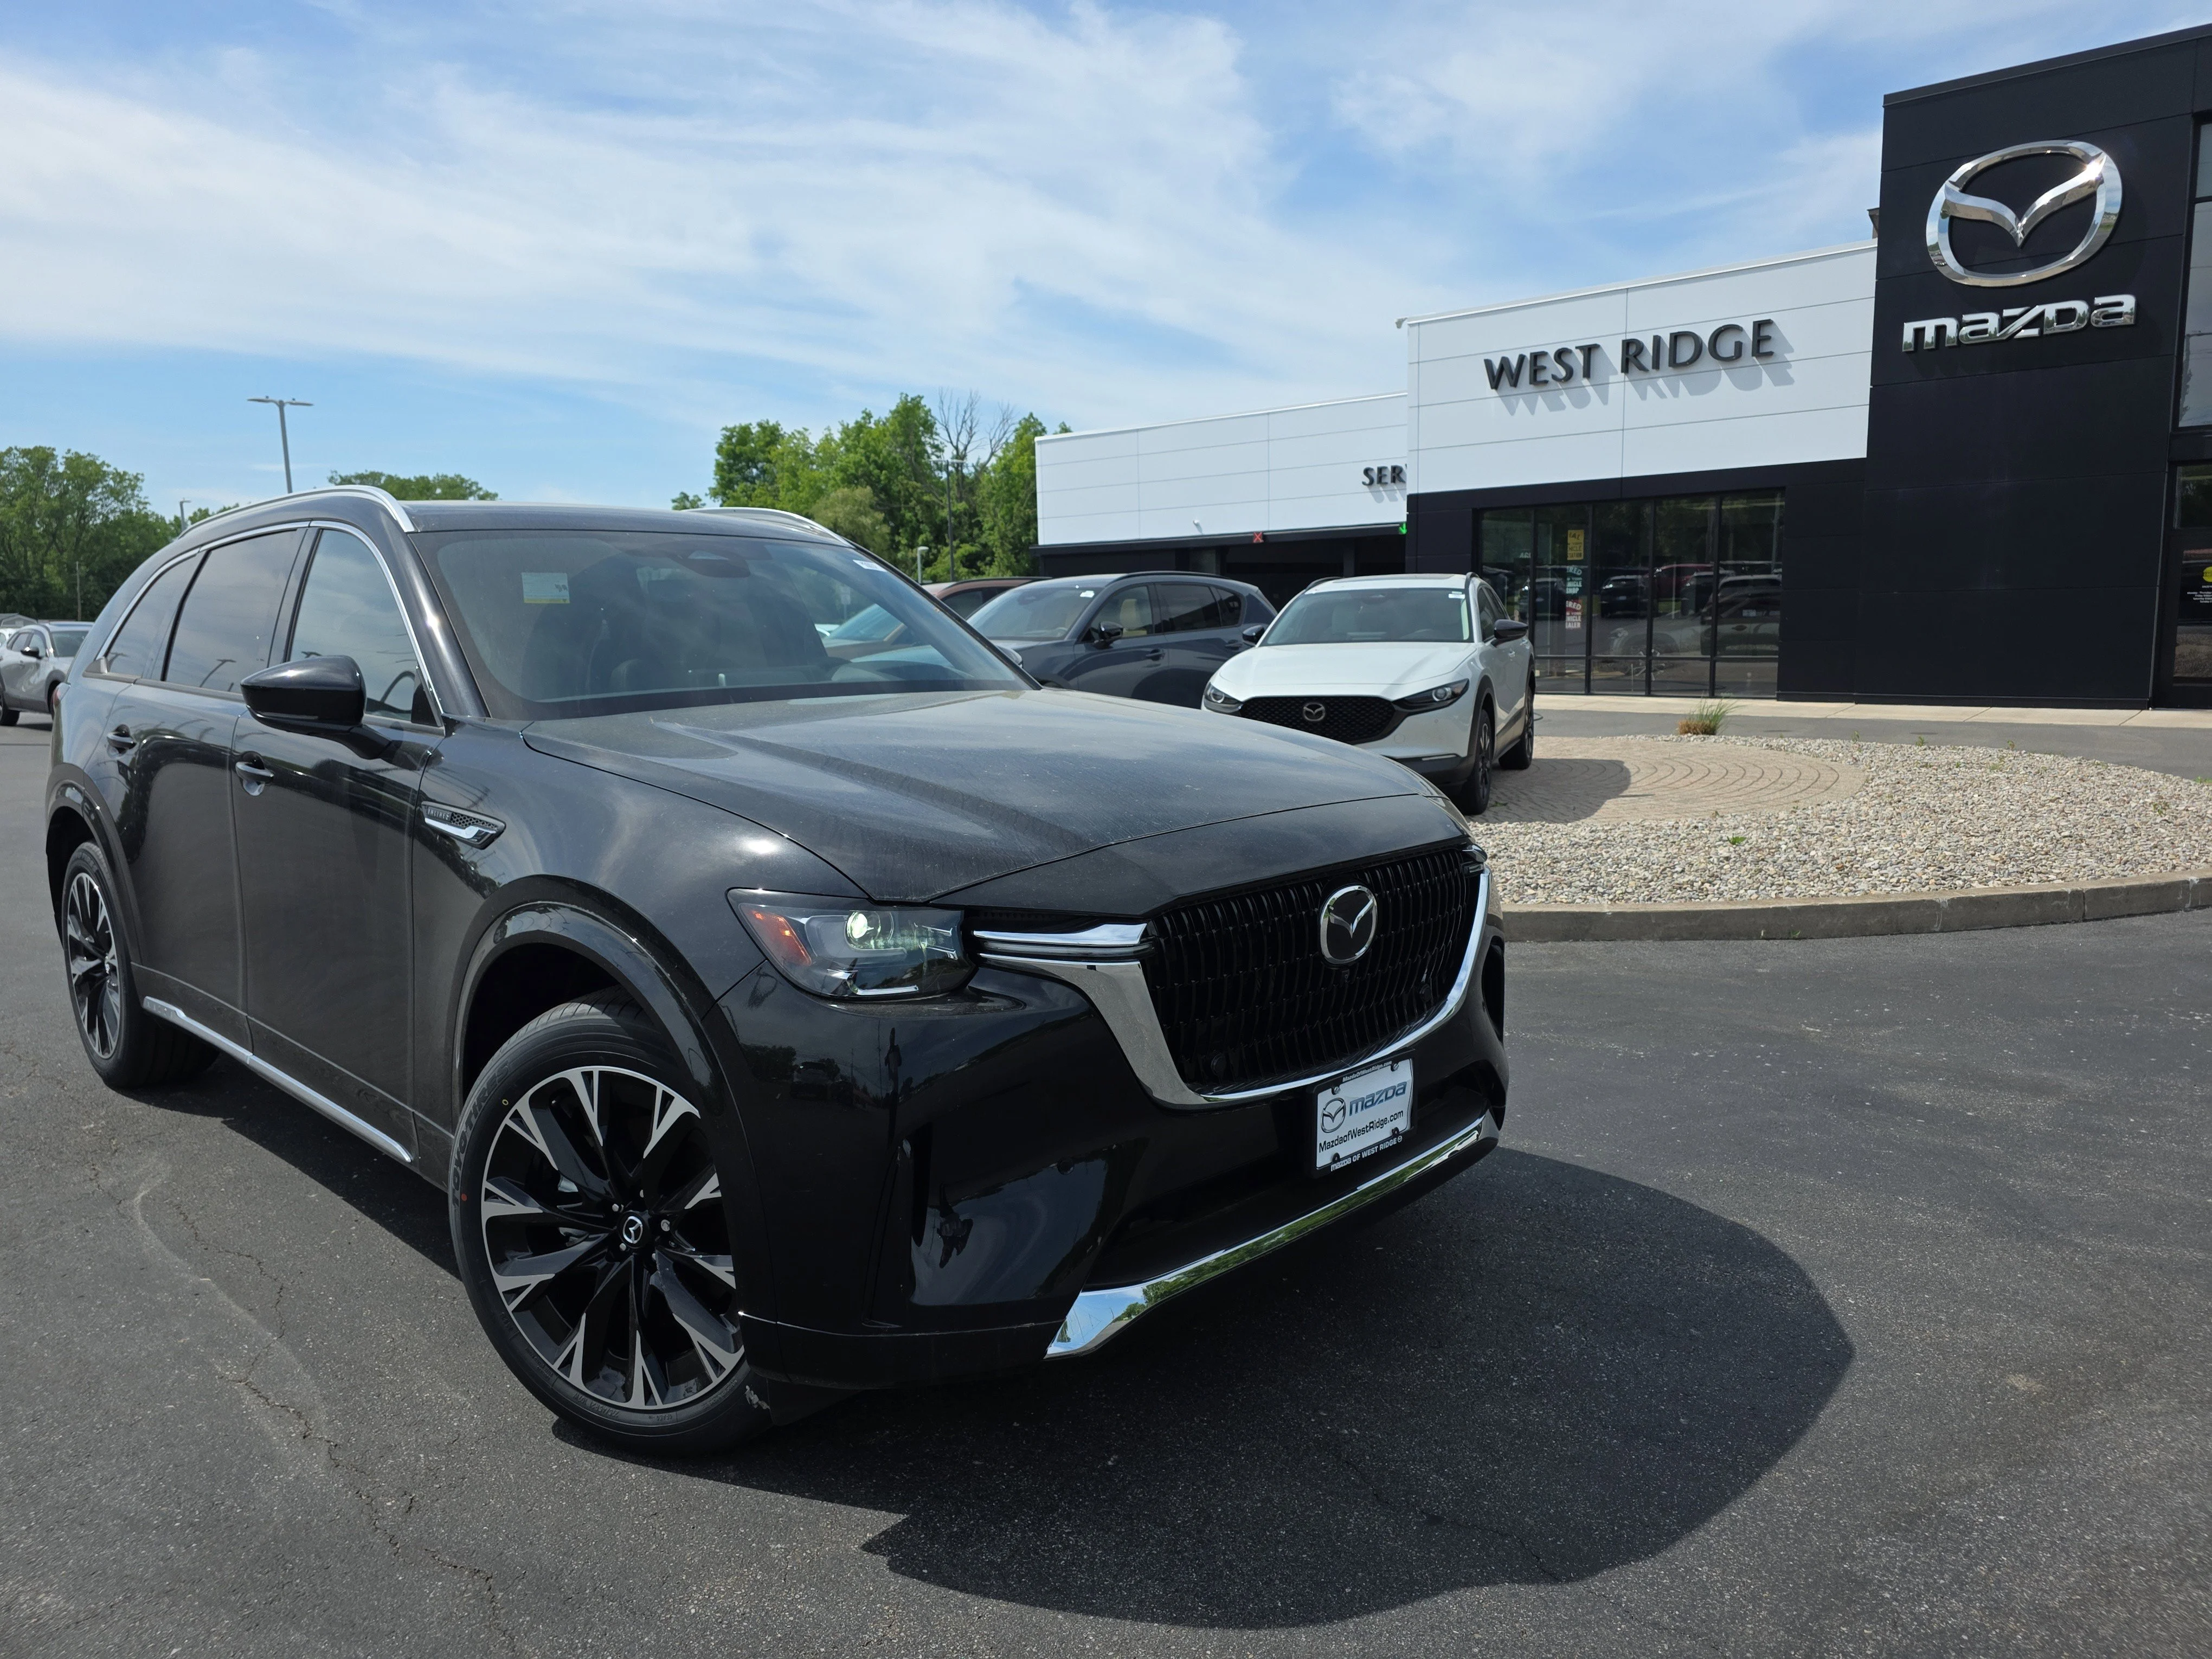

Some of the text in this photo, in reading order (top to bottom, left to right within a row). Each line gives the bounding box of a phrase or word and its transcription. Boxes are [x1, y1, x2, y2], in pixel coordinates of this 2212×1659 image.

[1483, 318, 1775, 390] WEST RIDGE
[1361, 464, 1407, 486] SER
[1342, 1060, 1392, 1083] MazdaOfWestRidge.com
[452, 1063, 511, 1208] TOYO TIRES
[1319, 1110, 1404, 1153] MazdaofWestRidge.com
[1352, 1154, 1361, 1163] OF
[1361, 1146, 1379, 1158] WEST
[1379, 1137, 1397, 1150] RIDGE
